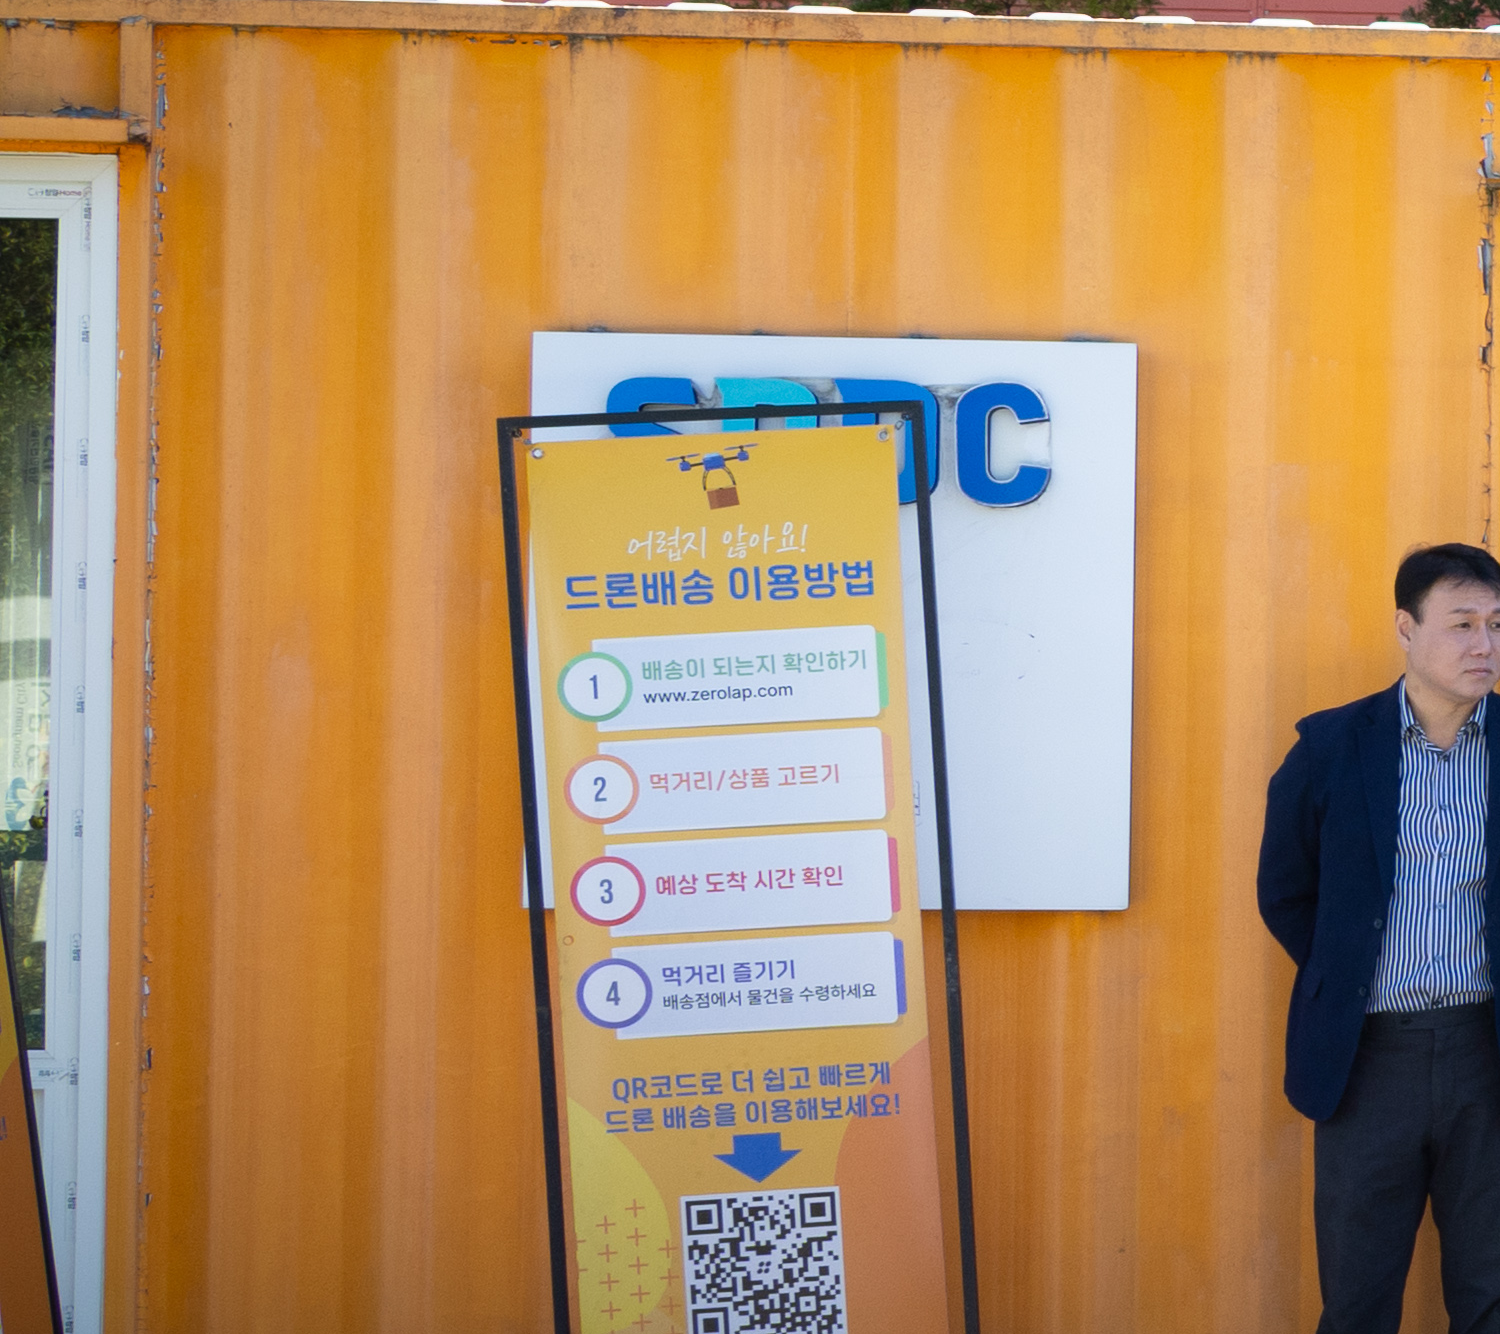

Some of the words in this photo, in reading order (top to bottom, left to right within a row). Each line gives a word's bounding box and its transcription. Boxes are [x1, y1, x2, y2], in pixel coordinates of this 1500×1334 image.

[625, 525, 710, 564] 어렵지
[722, 521, 810, 561] 않아요!
[562, 566, 717, 612] 드론배송
[727, 559, 877, 605] 이용방법
[640, 655, 707, 684] 배송이
[711, 651, 778, 679] 되는지
[781, 647, 868, 677] 확인하기
[588, 674, 601, 701] 1
[642, 681, 795, 706] www.zerolap.com
[593, 776, 608, 803] 2
[648, 765, 772, 795] 먹거리/상품
[776, 762, 842, 789] 고르기
[599, 878, 615, 905] 3
[653, 872, 700, 898] 예상
[703, 869, 749, 896] 도착
[752, 867, 796, 893] 시간
[799, 864, 845, 891] 확인
[660, 961, 727, 988] 먹거리
[732, 958, 798, 984] 즐기기
[605, 981, 622, 1007] 4
[661, 988, 743, 1013] 배송점에서
[745, 984, 795, 1009] 물건을
[797, 980, 879, 1005] 수령하세요
[610, 1067, 725, 1103] QR코드로
[731, 1067, 757, 1097] 더
[760, 1063, 811, 1095] 쉽고
[817, 1059, 893, 1090] 빠르게
[604, 1107, 655, 1135] 드론
[660, 1101, 738, 1132] 배송을
[743, 1092, 901, 1126] 이용해보세요!
